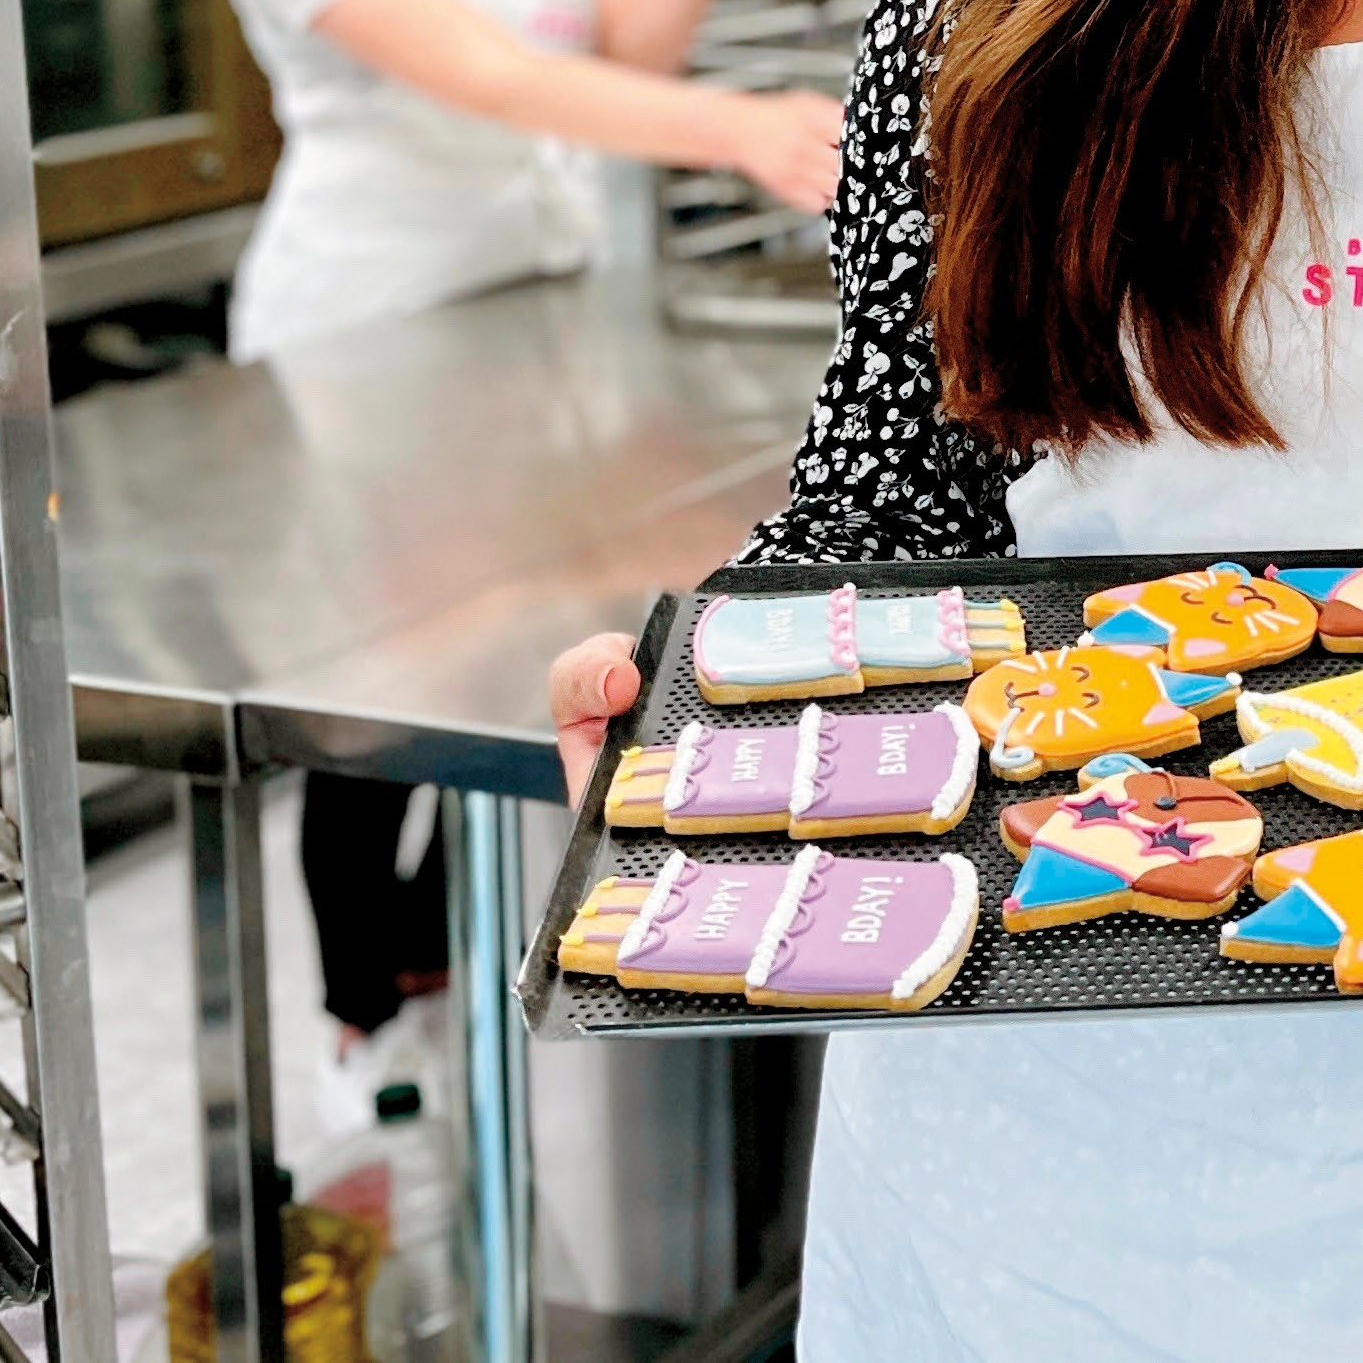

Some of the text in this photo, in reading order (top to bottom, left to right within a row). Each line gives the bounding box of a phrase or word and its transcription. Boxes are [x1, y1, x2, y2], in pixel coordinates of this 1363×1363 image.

[731, 738, 767, 782] HAPPY
[876, 723, 916, 776] BDAY!
[694, 878, 750, 940] HAPPY
[840, 875, 905, 943] BDAY!
